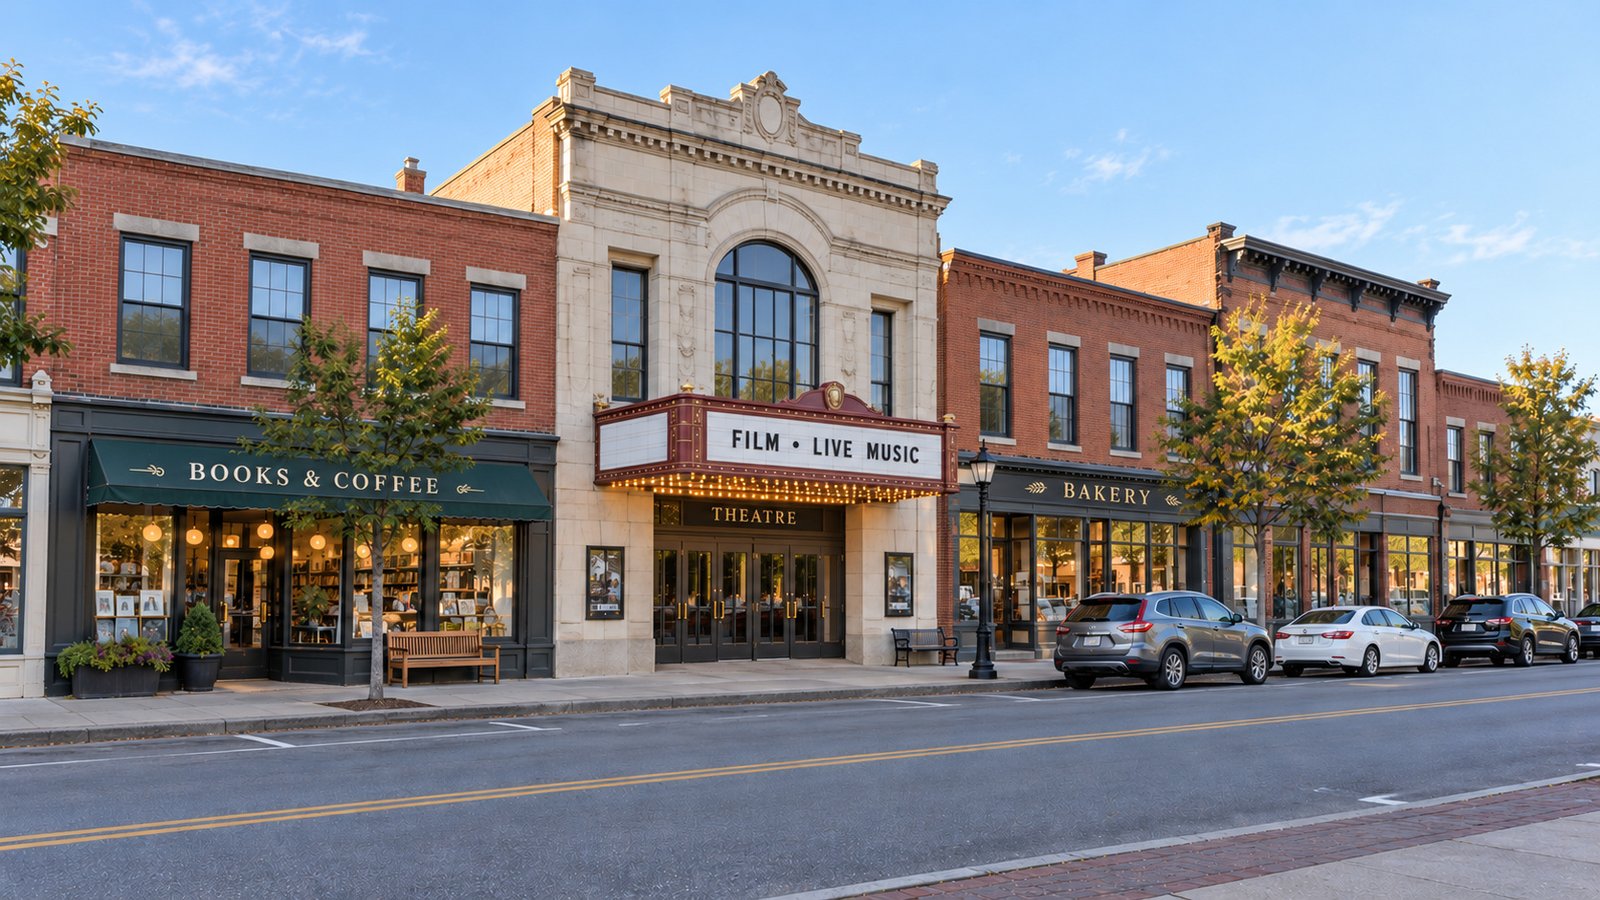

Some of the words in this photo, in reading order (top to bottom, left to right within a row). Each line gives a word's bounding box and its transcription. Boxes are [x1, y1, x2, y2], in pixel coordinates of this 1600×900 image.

[732, 429, 780, 452] FILM
[813, 437, 853, 459] LIVE
[866, 443, 920, 464] MUSIC
[189, 462, 289, 488] BOOKS
[303, 469, 321, 488] &
[334, 471, 439, 495] COFFEE
[1063, 482, 1151, 505] BAKERY
[711, 507, 797, 525] THEATRE
